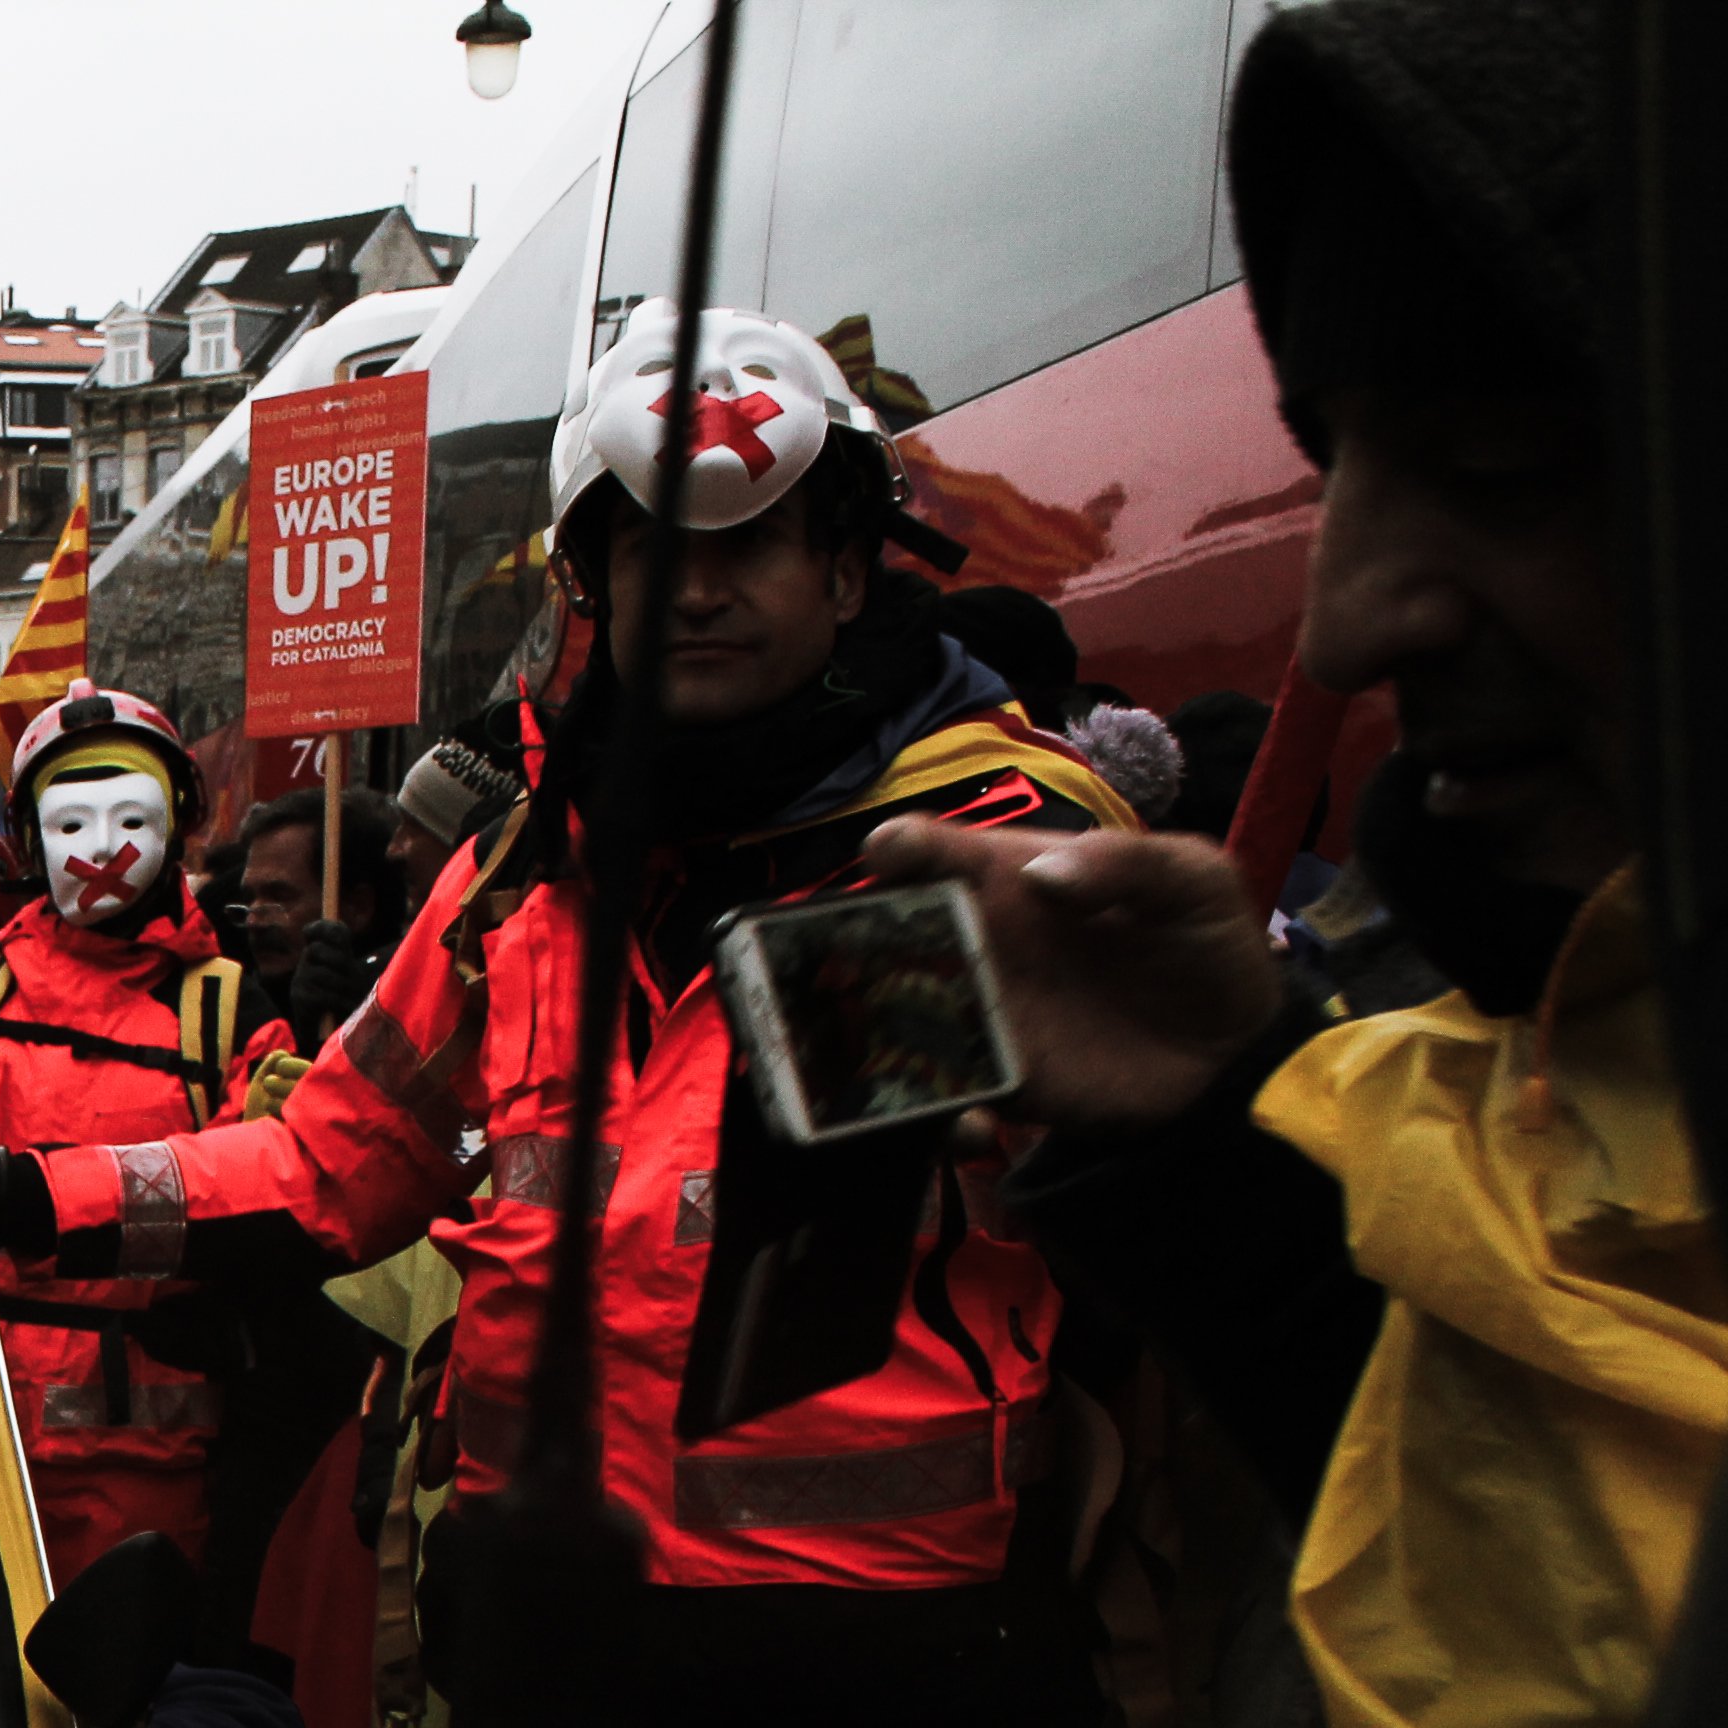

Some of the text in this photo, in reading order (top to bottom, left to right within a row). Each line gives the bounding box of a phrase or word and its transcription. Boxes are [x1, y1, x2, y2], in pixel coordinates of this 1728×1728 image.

[253, 404, 312, 425] freedom
[291, 420, 339, 440] human
[343, 412, 387, 433] rights
[336, 431, 425, 454] referendum
[274, 449, 394, 496] EUROPE
[274, 486, 392, 539] WAKE
[273, 532, 390, 615] UP!
[271, 616, 387, 648] DEMOCRACY
[271, 640, 386, 667] FOR CATALONIA
[348, 656, 413, 675] dialogue
